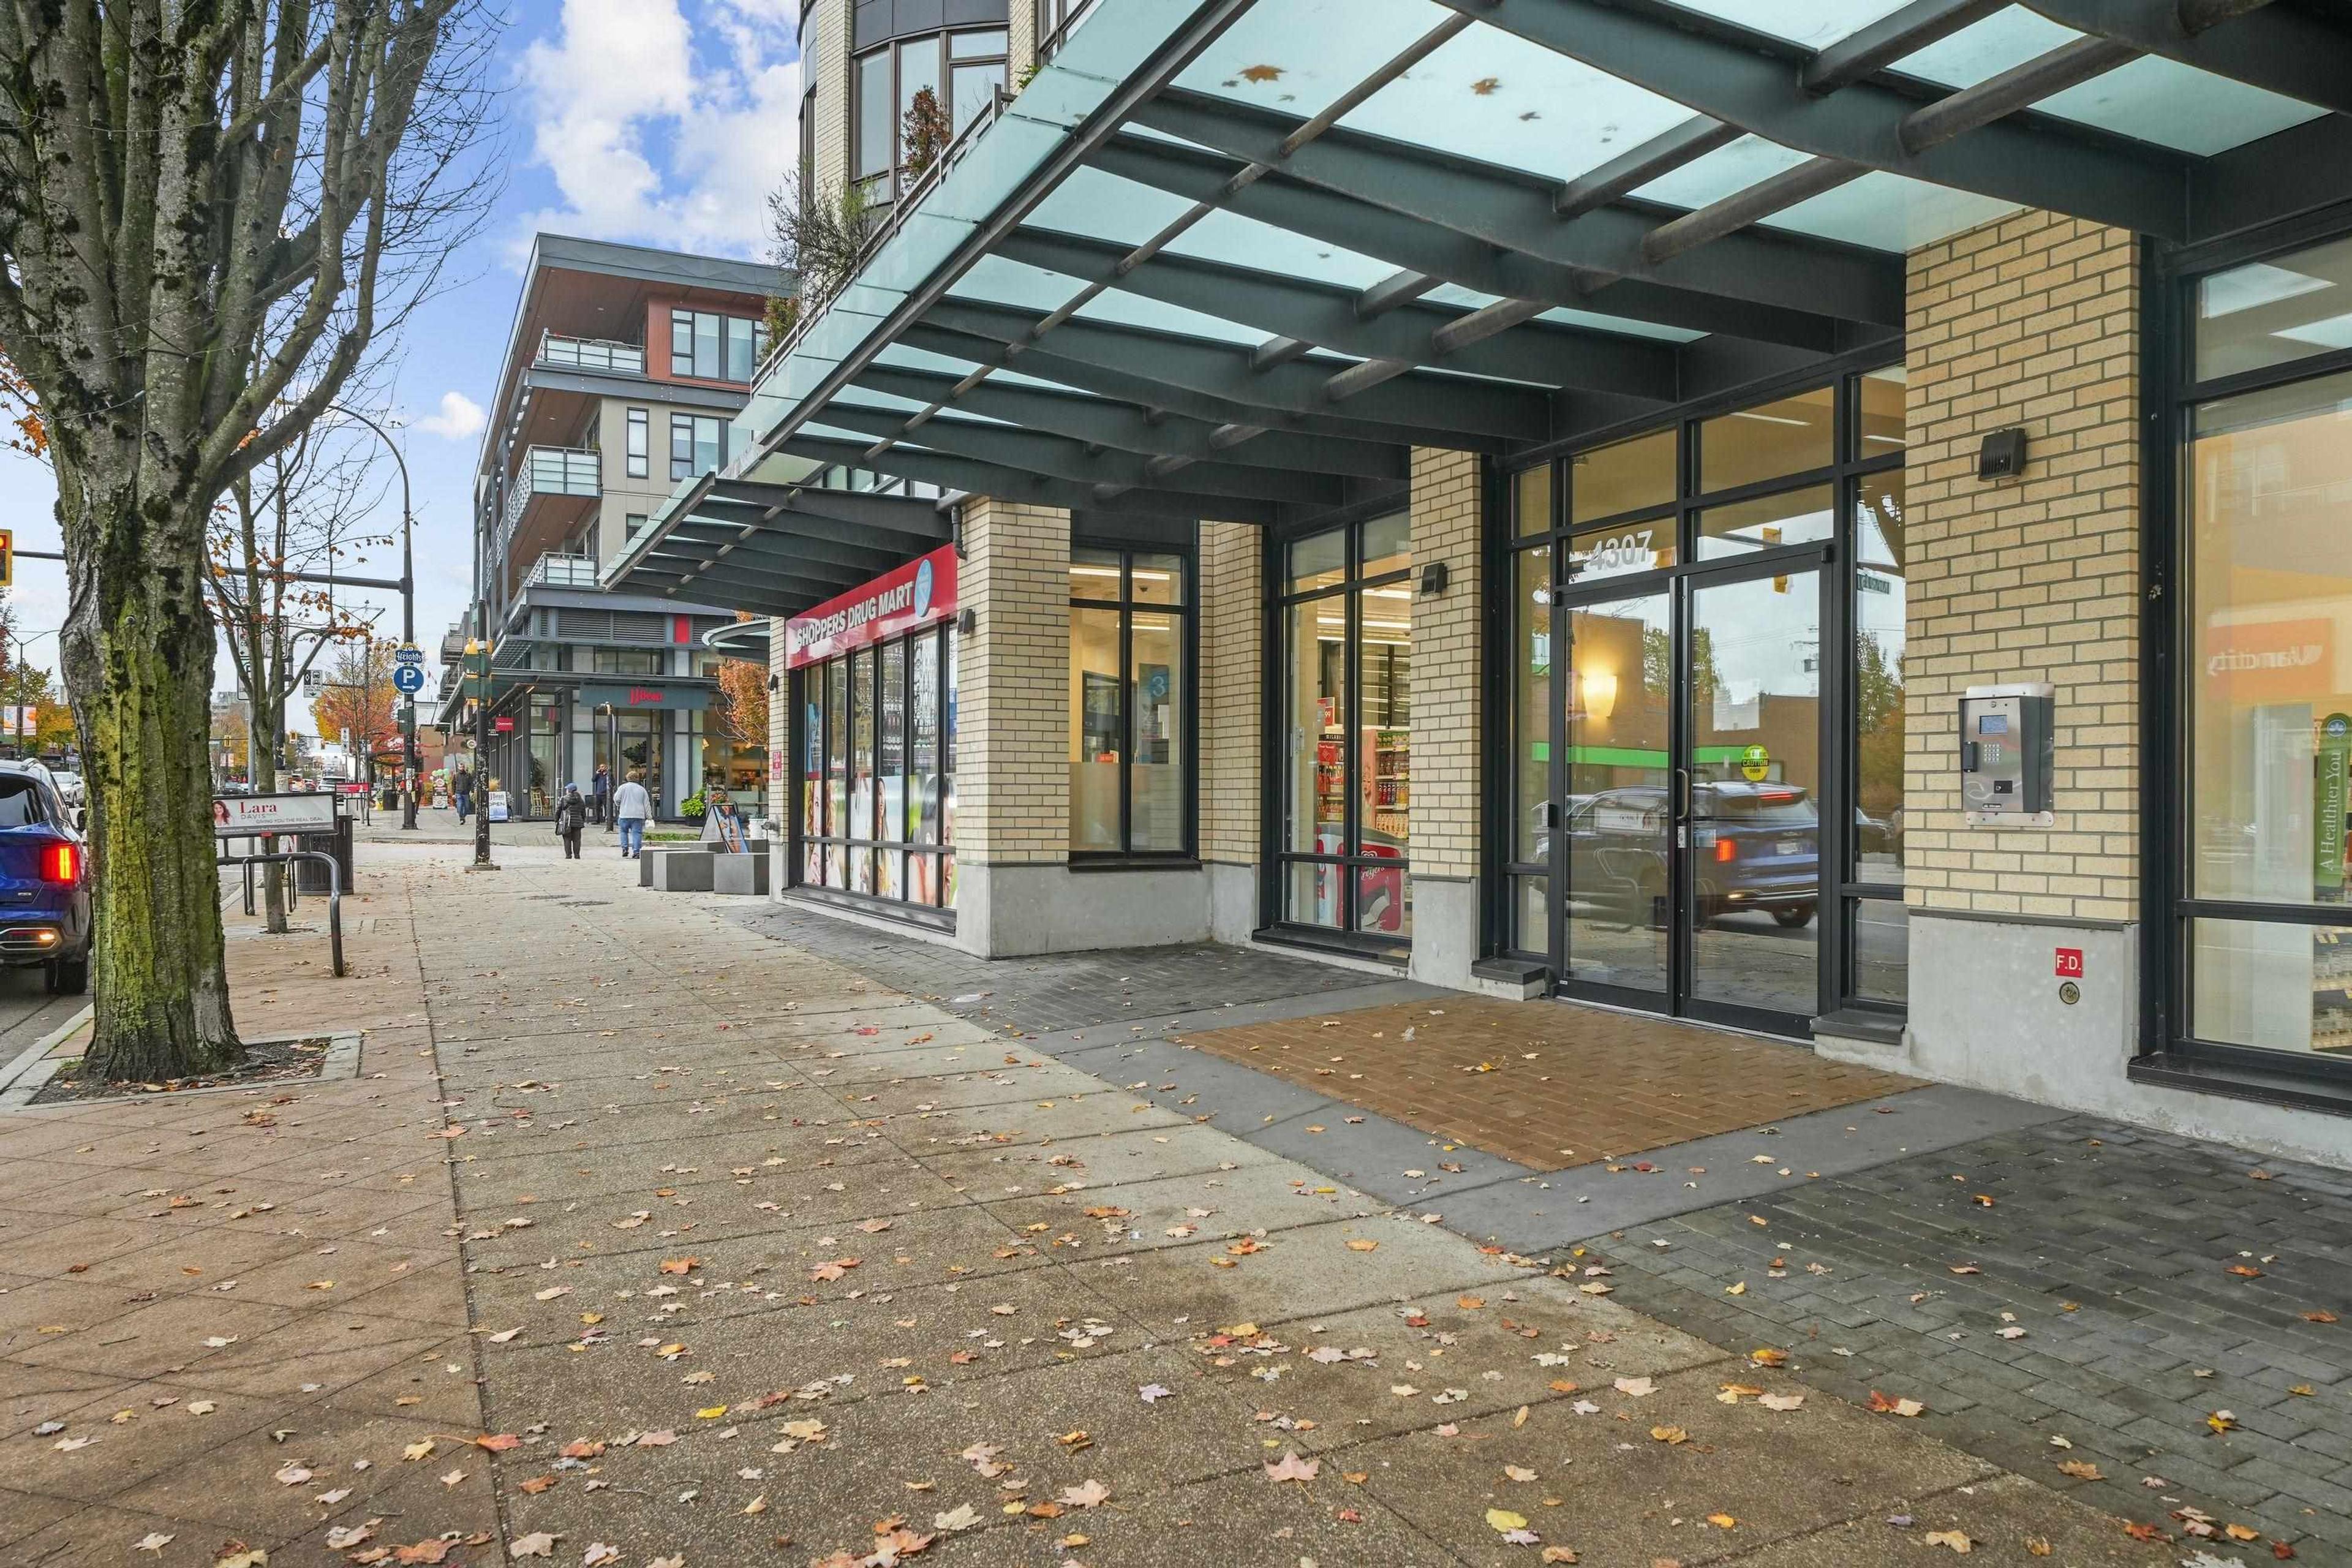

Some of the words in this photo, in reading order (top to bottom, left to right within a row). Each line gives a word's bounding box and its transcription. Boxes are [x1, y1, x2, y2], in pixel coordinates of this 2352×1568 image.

[1590, 530, 1653, 570] 4307
[797, 610, 846, 647] SHOPPERS
[847, 597, 878, 628] DRUG
[878, 581, 914, 617] MART
[397, 651, 422, 662] Heights
[403, 669, 416, 684] P
[1152, 676, 1166, 697] 3
[2325, 752, 2342, 780] You
[239, 801, 277, 814] Lara
[2321, 783, 2339, 854] Healthier
[2320, 858, 2334, 872] A
[2057, 955, 2081, 971] F.D.
